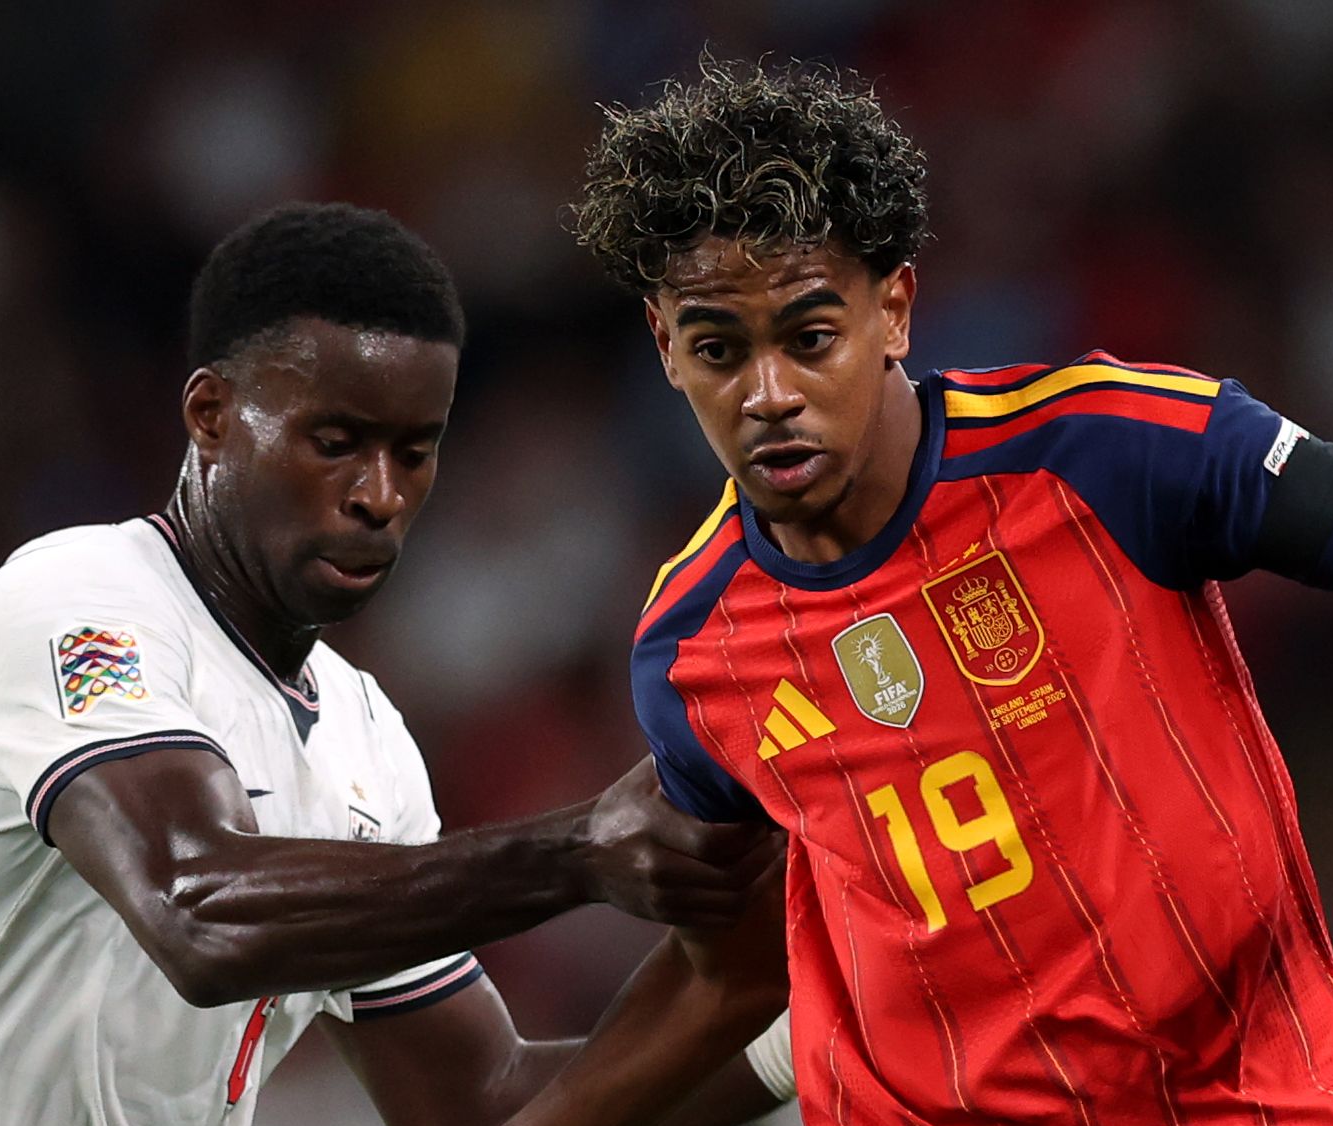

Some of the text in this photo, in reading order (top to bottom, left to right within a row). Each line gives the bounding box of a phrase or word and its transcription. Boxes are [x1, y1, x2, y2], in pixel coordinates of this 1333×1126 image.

[1268, 441, 1287, 469] UEFA
[874, 682, 907, 705] FIFA
[991, 696, 1024, 718] ENGLAND
[1030, 683, 1054, 700] SPAIN
[1001, 699, 1044, 725] SEPTEMBER
[1017, 709, 1047, 730] LONDON
[866, 750, 1034, 934] 19
